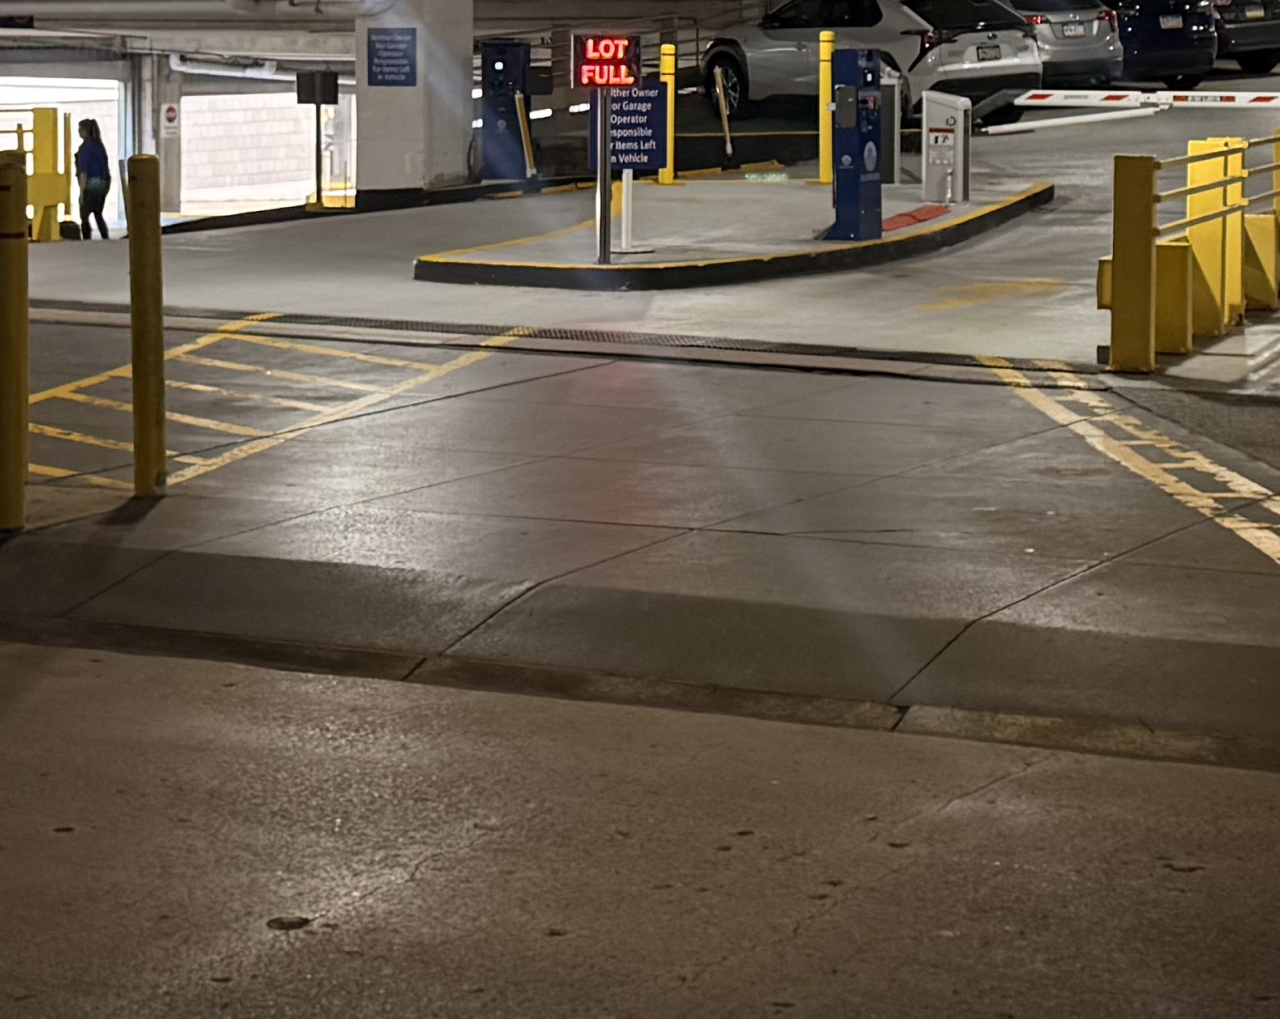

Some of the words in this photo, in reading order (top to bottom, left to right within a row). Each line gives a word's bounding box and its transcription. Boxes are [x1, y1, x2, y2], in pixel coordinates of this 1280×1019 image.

[586, 38, 629, 60] LOT
[581, 64, 635, 85] FULL
[631, 87, 659, 98] Owner
[622, 101, 652, 112] Garage
[610, 114, 648, 126] Operator
[640, 140, 656, 150] Left
[618, 153, 649, 163] Vehicle
